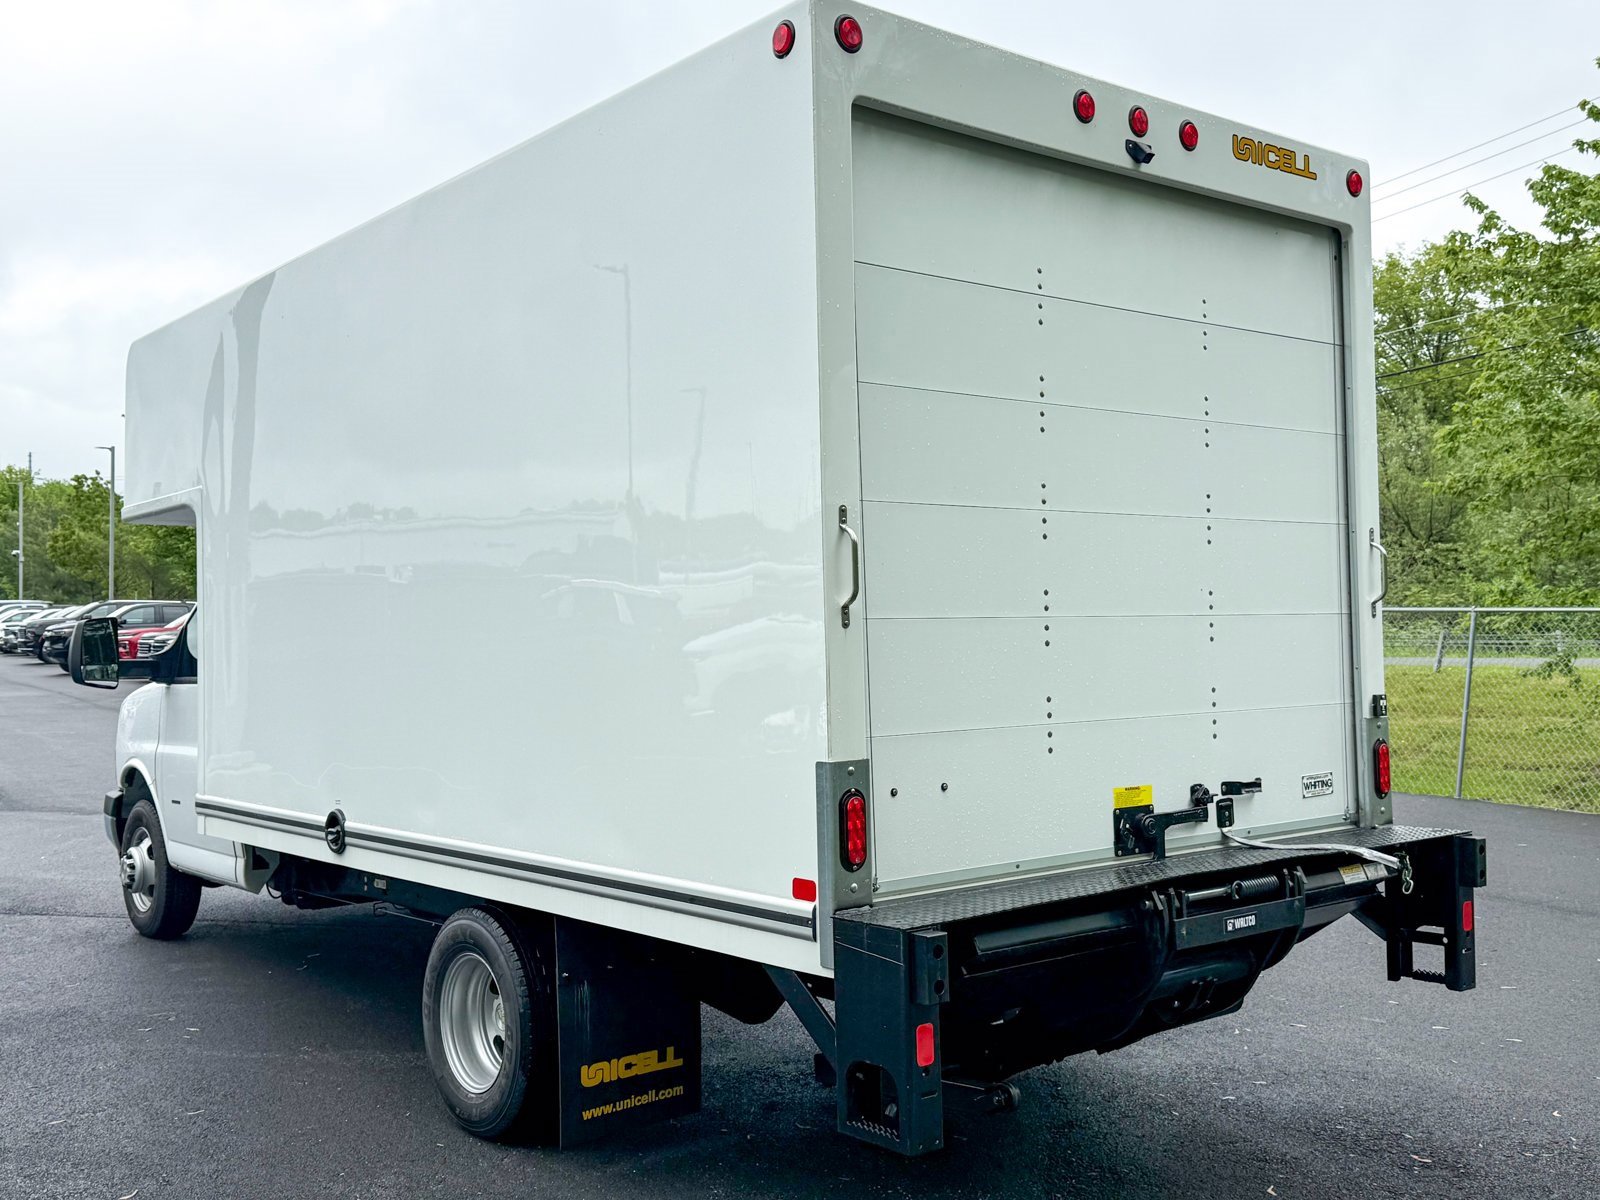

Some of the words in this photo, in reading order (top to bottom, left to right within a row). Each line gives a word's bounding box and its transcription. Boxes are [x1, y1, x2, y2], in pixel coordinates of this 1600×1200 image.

[1232, 134, 1317, 180] UNICELL
[1303, 778, 1332, 790] WHITING
[1235, 915, 1256, 929] WALTCO
[580, 1046, 683, 1088] UNICELL
[582, 1085, 684, 1120] www.unicell.com
